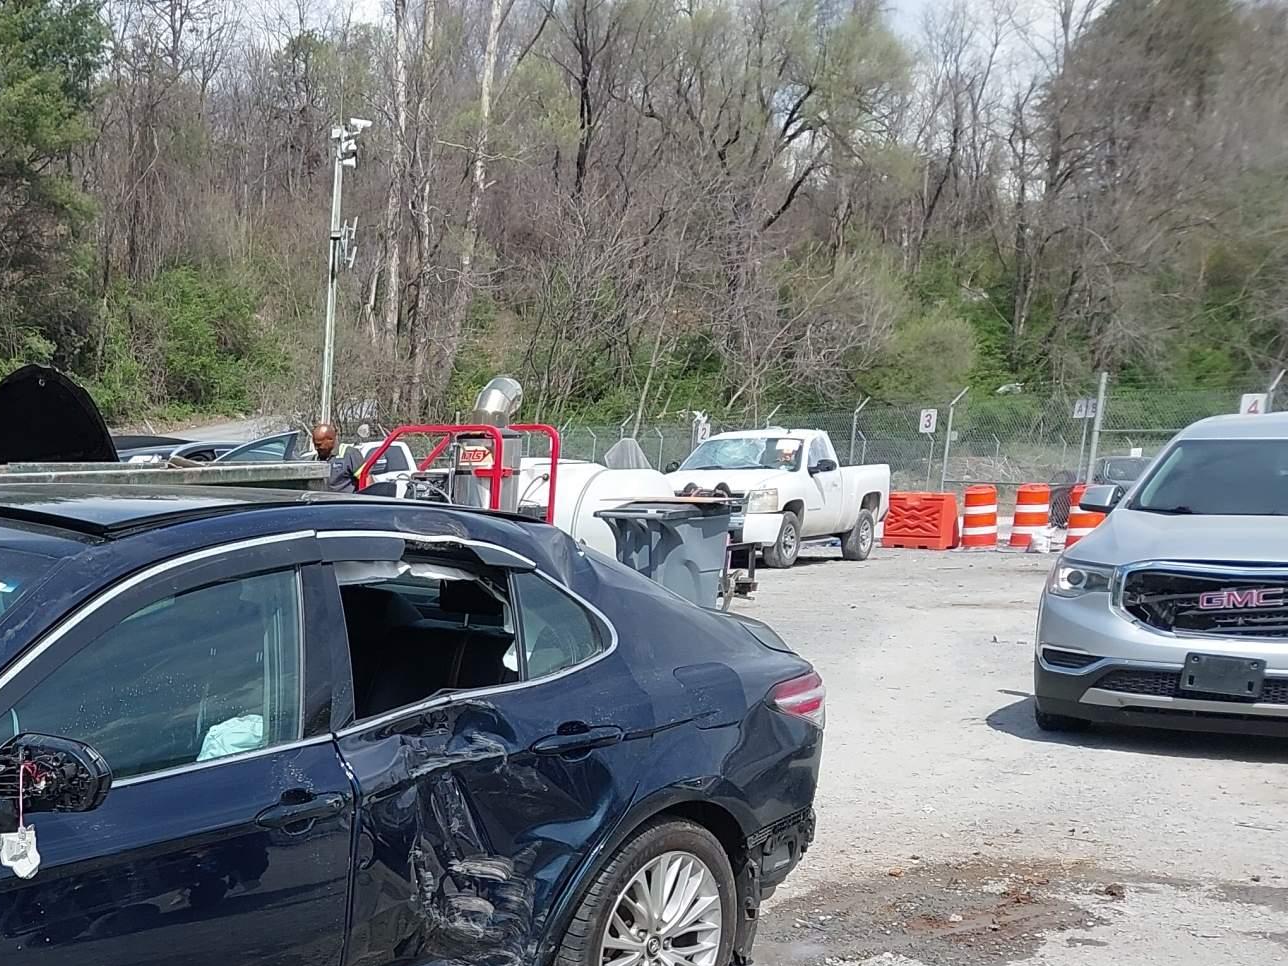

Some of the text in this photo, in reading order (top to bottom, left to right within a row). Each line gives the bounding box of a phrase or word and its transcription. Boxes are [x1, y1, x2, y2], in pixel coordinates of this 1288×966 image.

[1076, 404, 1083, 415] A
[1247, 398, 1260, 414] 4
[923, 413, 933, 429] 3
[700, 427, 707, 440] 2
[1199, 587, 1284, 610] GMC
